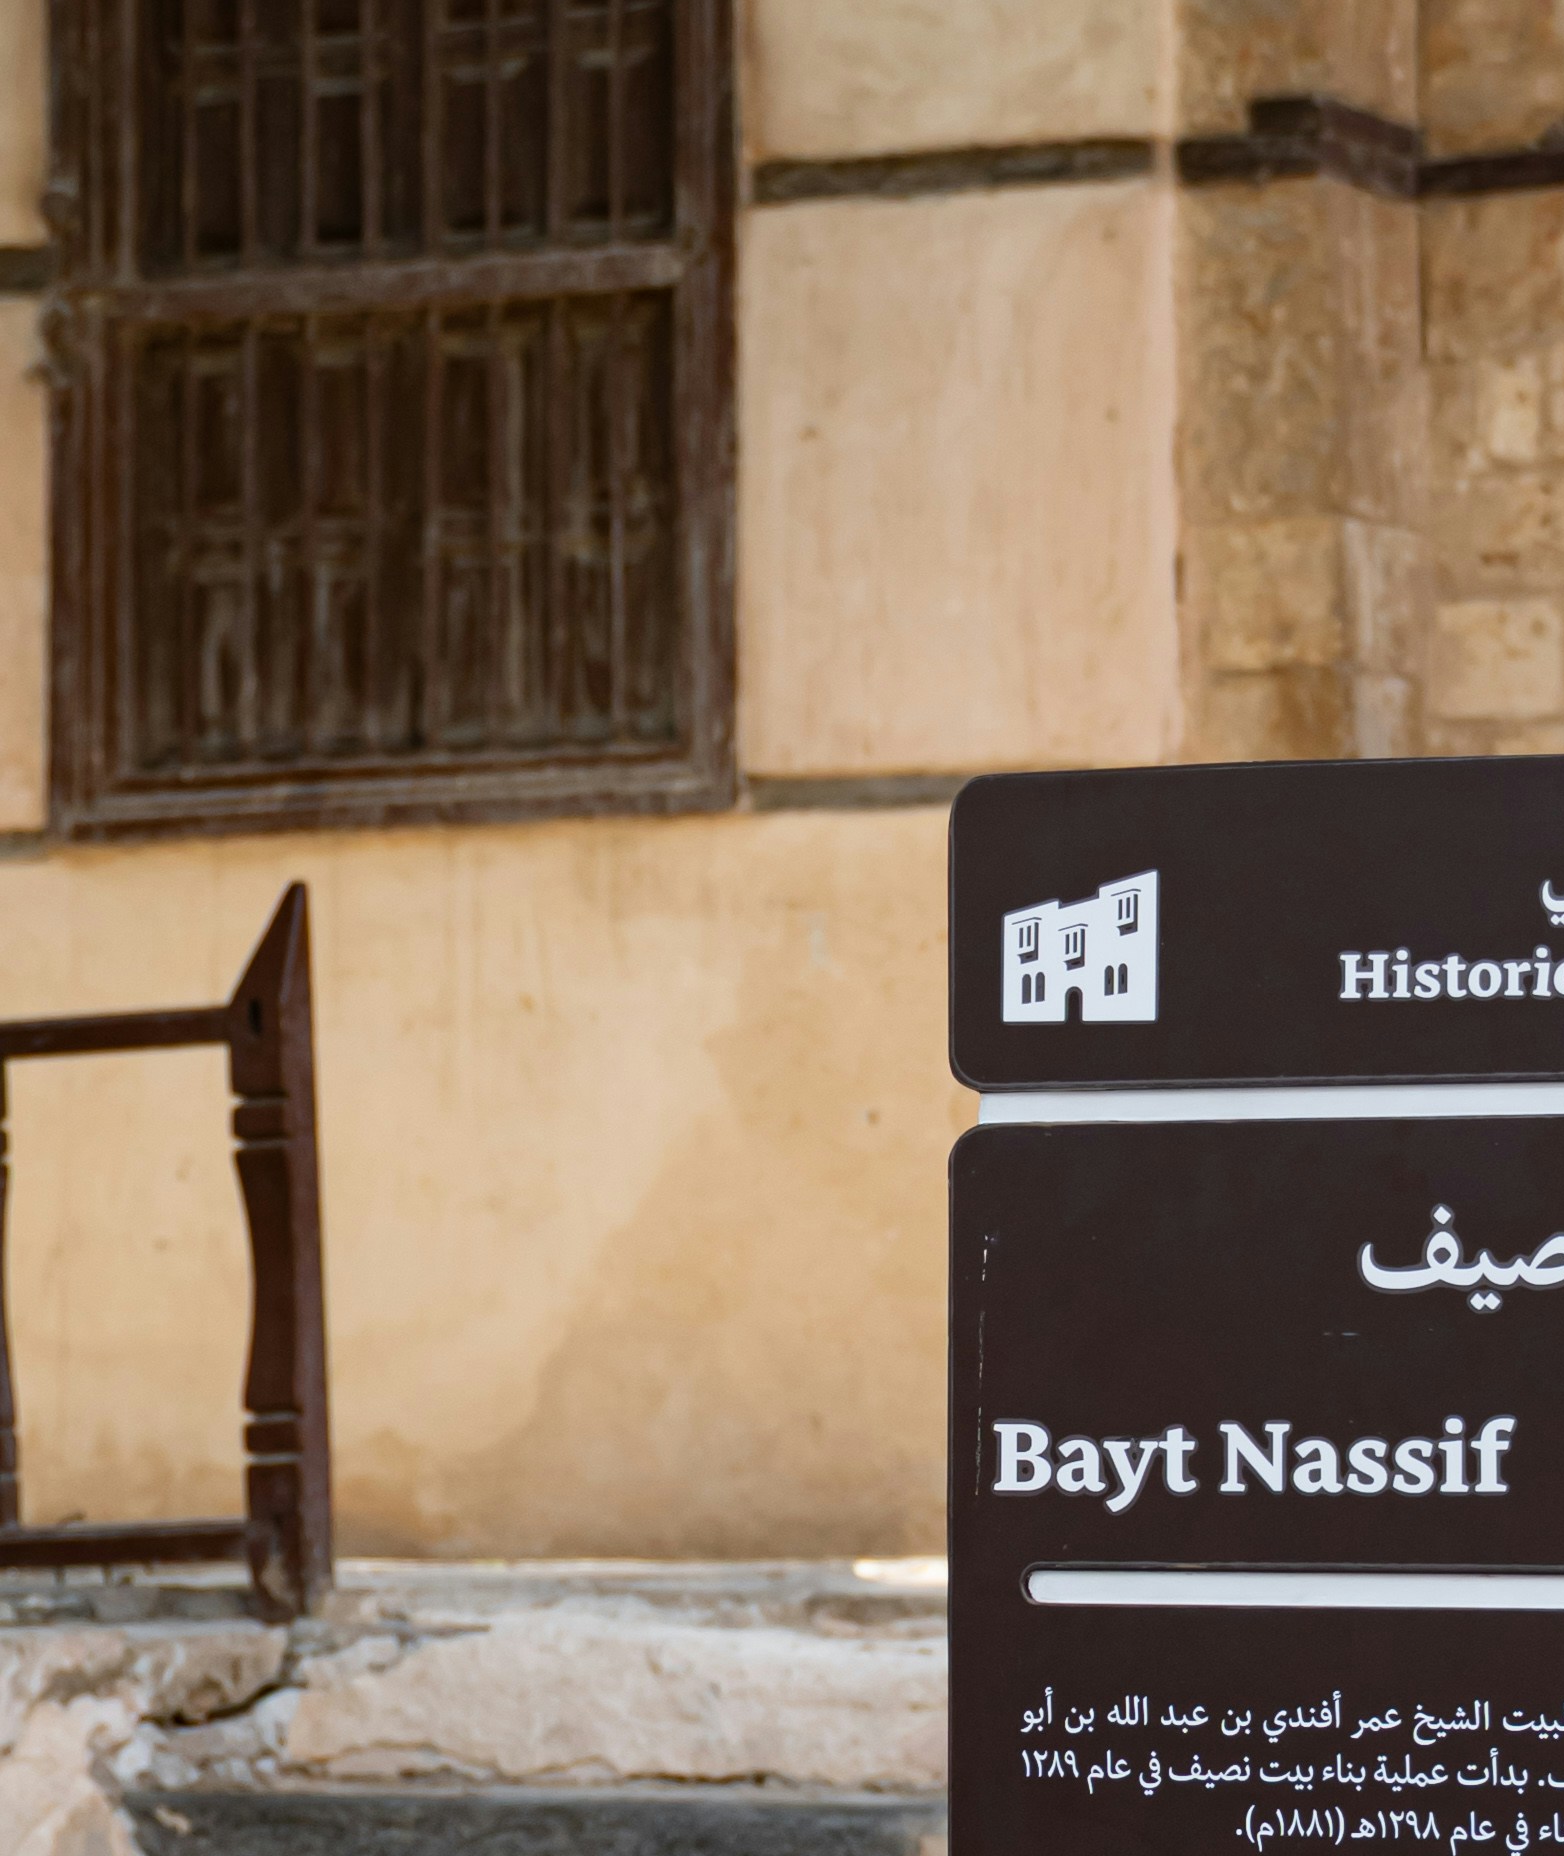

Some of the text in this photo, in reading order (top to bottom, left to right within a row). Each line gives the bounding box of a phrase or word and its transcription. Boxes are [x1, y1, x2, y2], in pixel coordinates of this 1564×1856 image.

[993, 1417, 1516, 1513] Bayt Nassif
[1020, 1685, 1054, 1734] أبو
[1064, 1706, 1095, 1735] بن
[1106, 1693, 1149, 1727] الله
[1160, 1703, 1209, 1735] عبد
[1220, 1708, 1252, 1737] بن
[1262, 1689, 1342, 1744] أفندي
[1349, 1707, 1402, 1740] عمر
[1412, 1698, 1490, 1747] الشيخ
[1021, 1749, 1080, 1780] ١٢٨٩
[1086, 1748, 1132, 1795] عام
[1138, 1749, 1162, 1797] في
[1168, 1753, 1251, 1790] نصيف
[1259, 1760, 1315, 1791] بيت
[1321, 1751, 1367, 1792] بناء
[1373, 1753, 1449, 1793] عملية
[1456, 1746, 1529, 1796] بدأت
